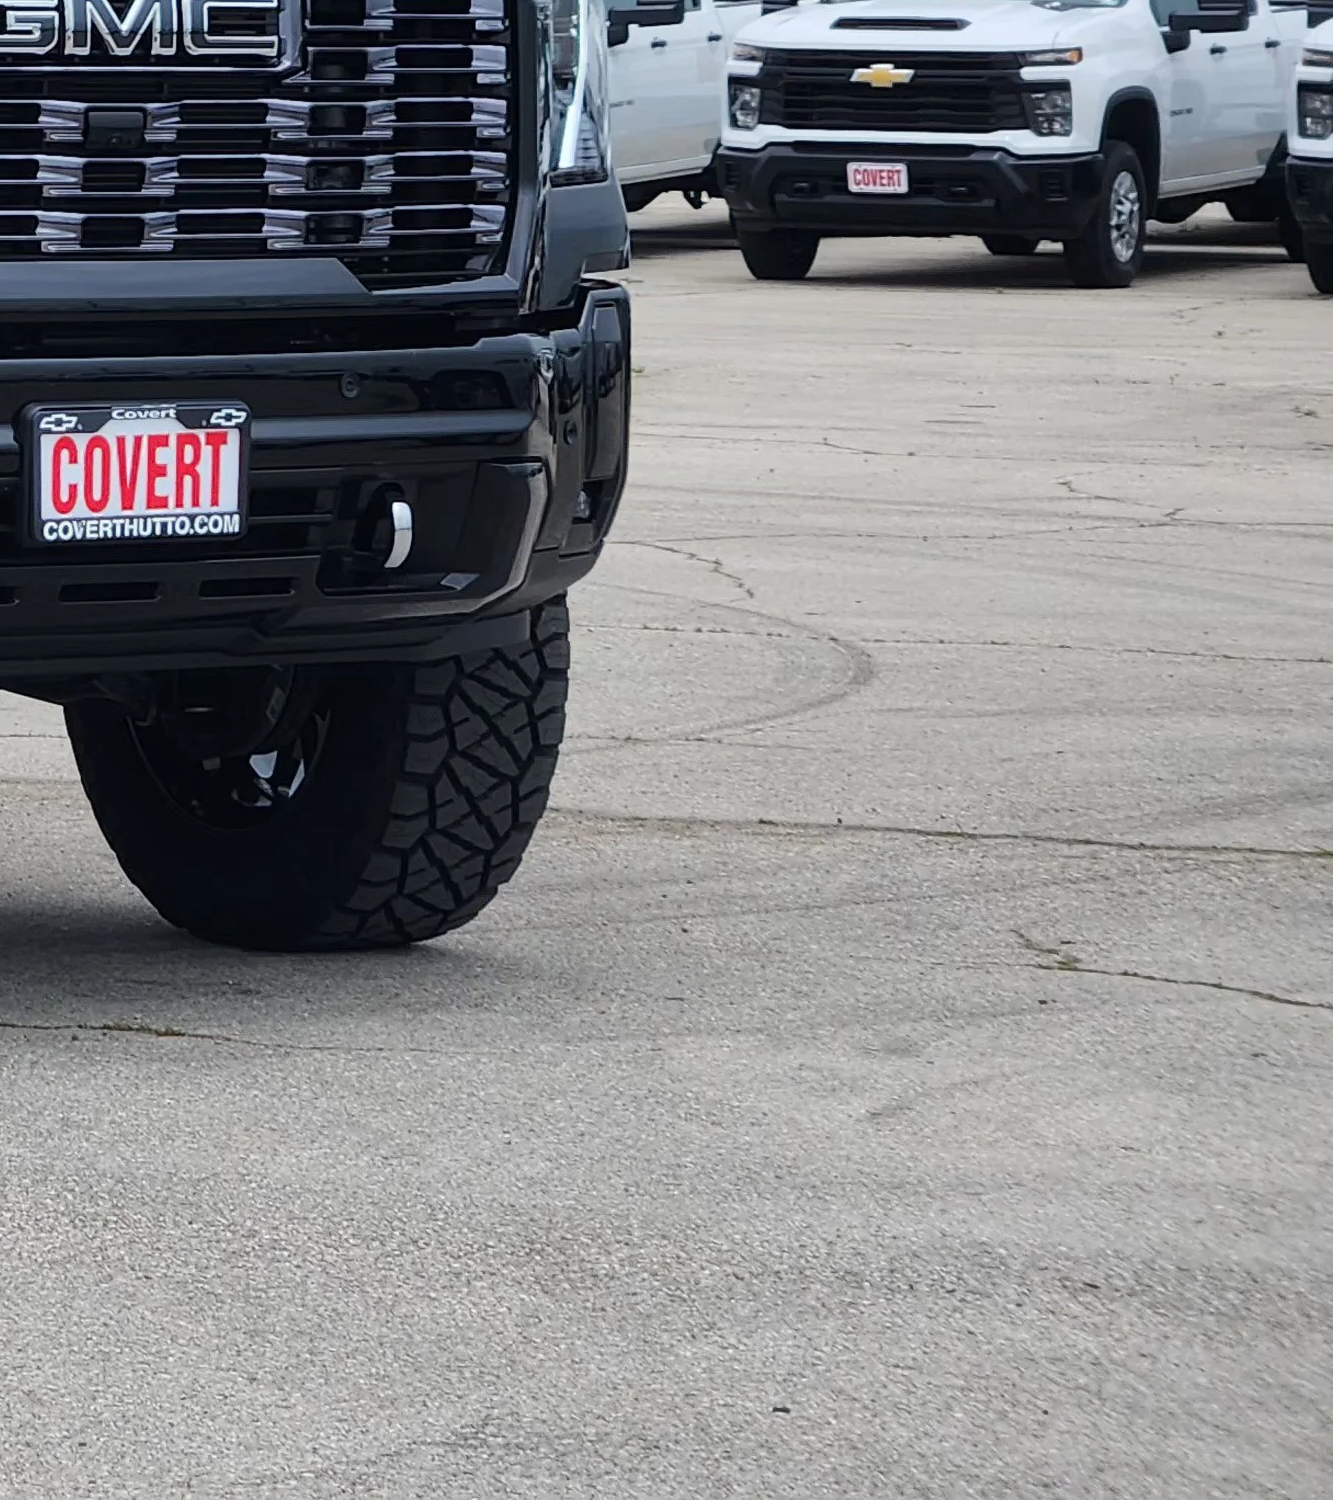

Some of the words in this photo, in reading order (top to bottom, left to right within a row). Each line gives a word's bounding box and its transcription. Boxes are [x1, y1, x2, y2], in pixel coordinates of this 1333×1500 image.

[854, 168, 901, 187] COVERT
[111, 408, 176, 420] Covert
[51, 431, 228, 515] COVERT
[42, 513, 240, 541] COVERTHUTTO.COM
